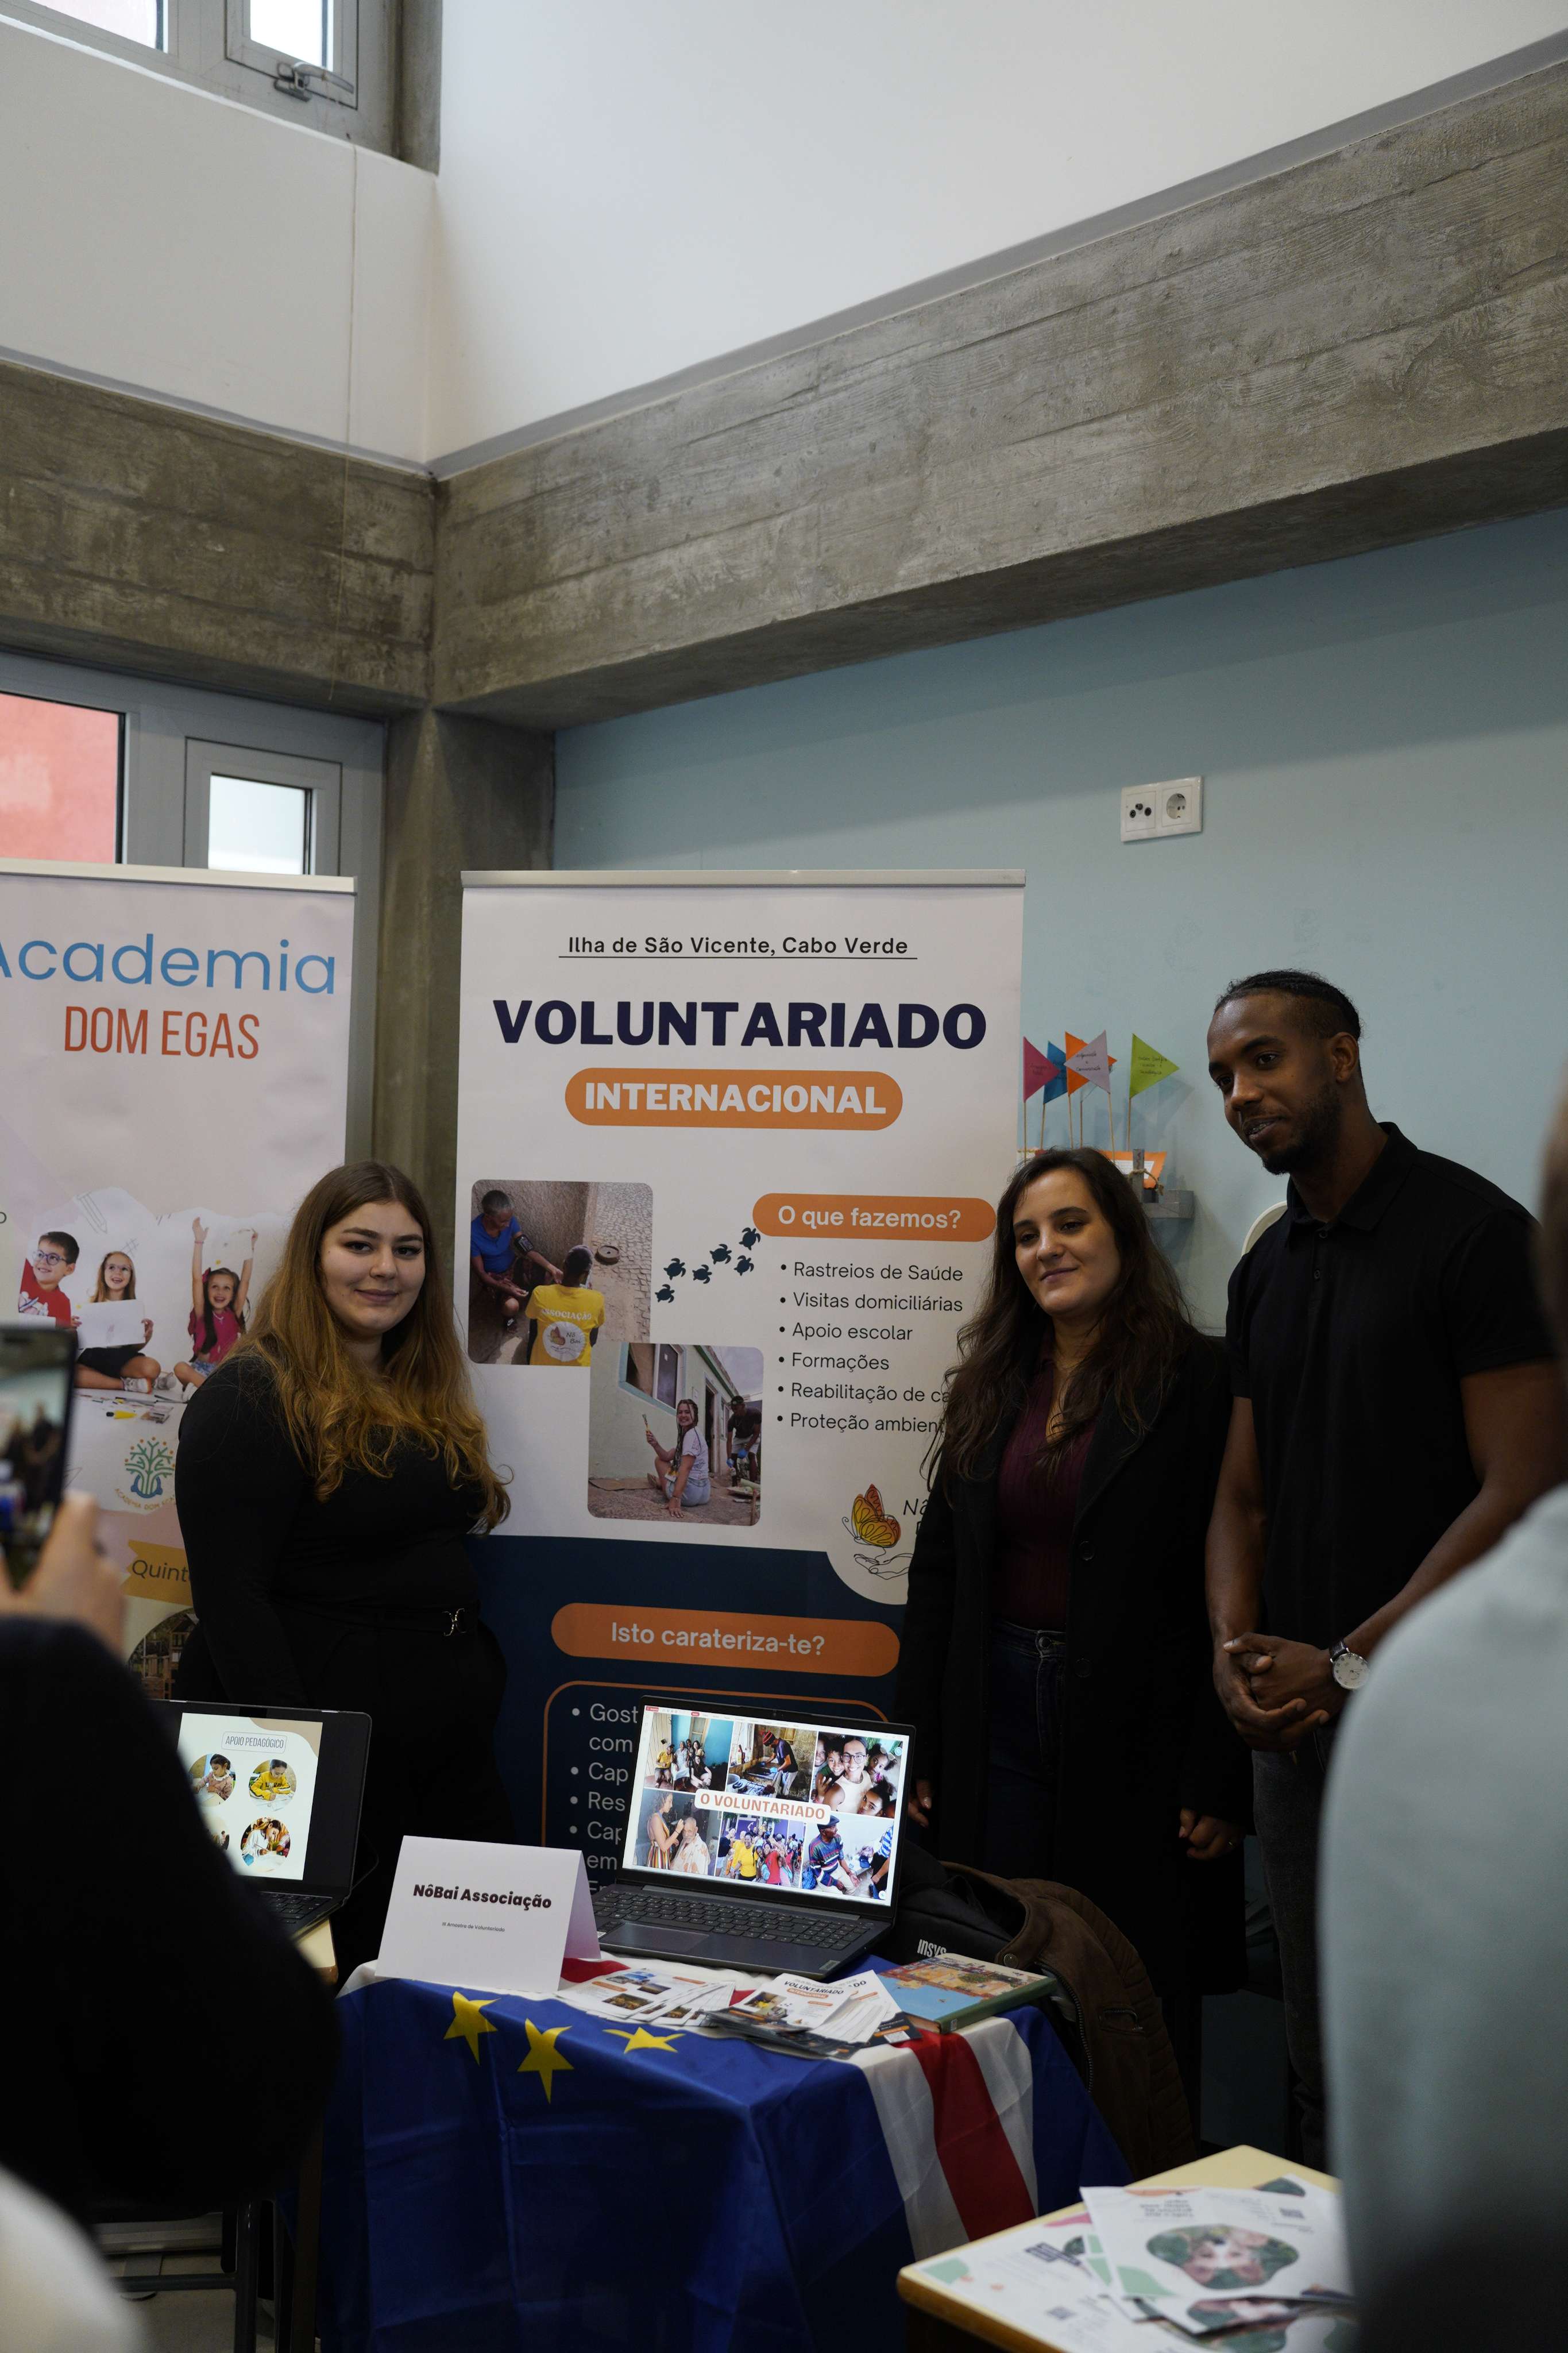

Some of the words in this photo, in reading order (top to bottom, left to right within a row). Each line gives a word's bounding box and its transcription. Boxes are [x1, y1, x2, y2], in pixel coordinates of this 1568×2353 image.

[569, 936, 604, 953] Ilha
[612, 937, 637, 953] de
[644, 937, 683, 953] São
[690, 937, 775, 956] Vicente,
[782, 936, 837, 954] Cabo
[844, 937, 907, 954] Verde
[0, 933, 335, 994] cademia
[64, 1006, 148, 1055] DOM
[161, 1010, 260, 1059] EGAS
[492, 1000, 987, 1050] VOLUNTARIADO
[585, 1082, 886, 1114] INTERNACIONAL
[778, 1205, 795, 1224] O
[802, 1210, 844, 1229] que
[850, 1208, 961, 1229] fazemos?
[794, 1262, 874, 1279] Rastreios
[880, 1264, 902, 1279] de
[908, 1265, 963, 1281] Saúde
[793, 1291, 849, 1308] Visitas
[855, 1294, 963, 1312] domiciliárias
[792, 1322, 842, 1341] Apoio
[848, 1325, 913, 1340] escolar
[792, 1352, 889, 1373] Formações
[791, 1382, 897, 1404] Reabilitação
[903, 1387, 925, 1402] de
[791, 1413, 869, 1433] Proteção
[612, 1622, 655, 1644] Isto
[661, 1628, 825, 1655] carateriza-te?
[590, 1703, 639, 1724] Gost
[225, 1736, 245, 1746] APOIO
[245, 1737, 284, 1749] PEDAGÓGICO
[589, 1737, 633, 1753] com
[589, 1762, 629, 1786] Cap
[588, 1791, 625, 1811] Res
[700, 1793, 710, 1805] O
[715, 1794, 825, 1820] VOLUNTARIADO
[586, 1854, 617, 1870] em
[413, 1884, 459, 1900] NôBai
[460, 1888, 551, 1911] Associação
[784, 1980, 844, 1995] VOLUNTARIADO
